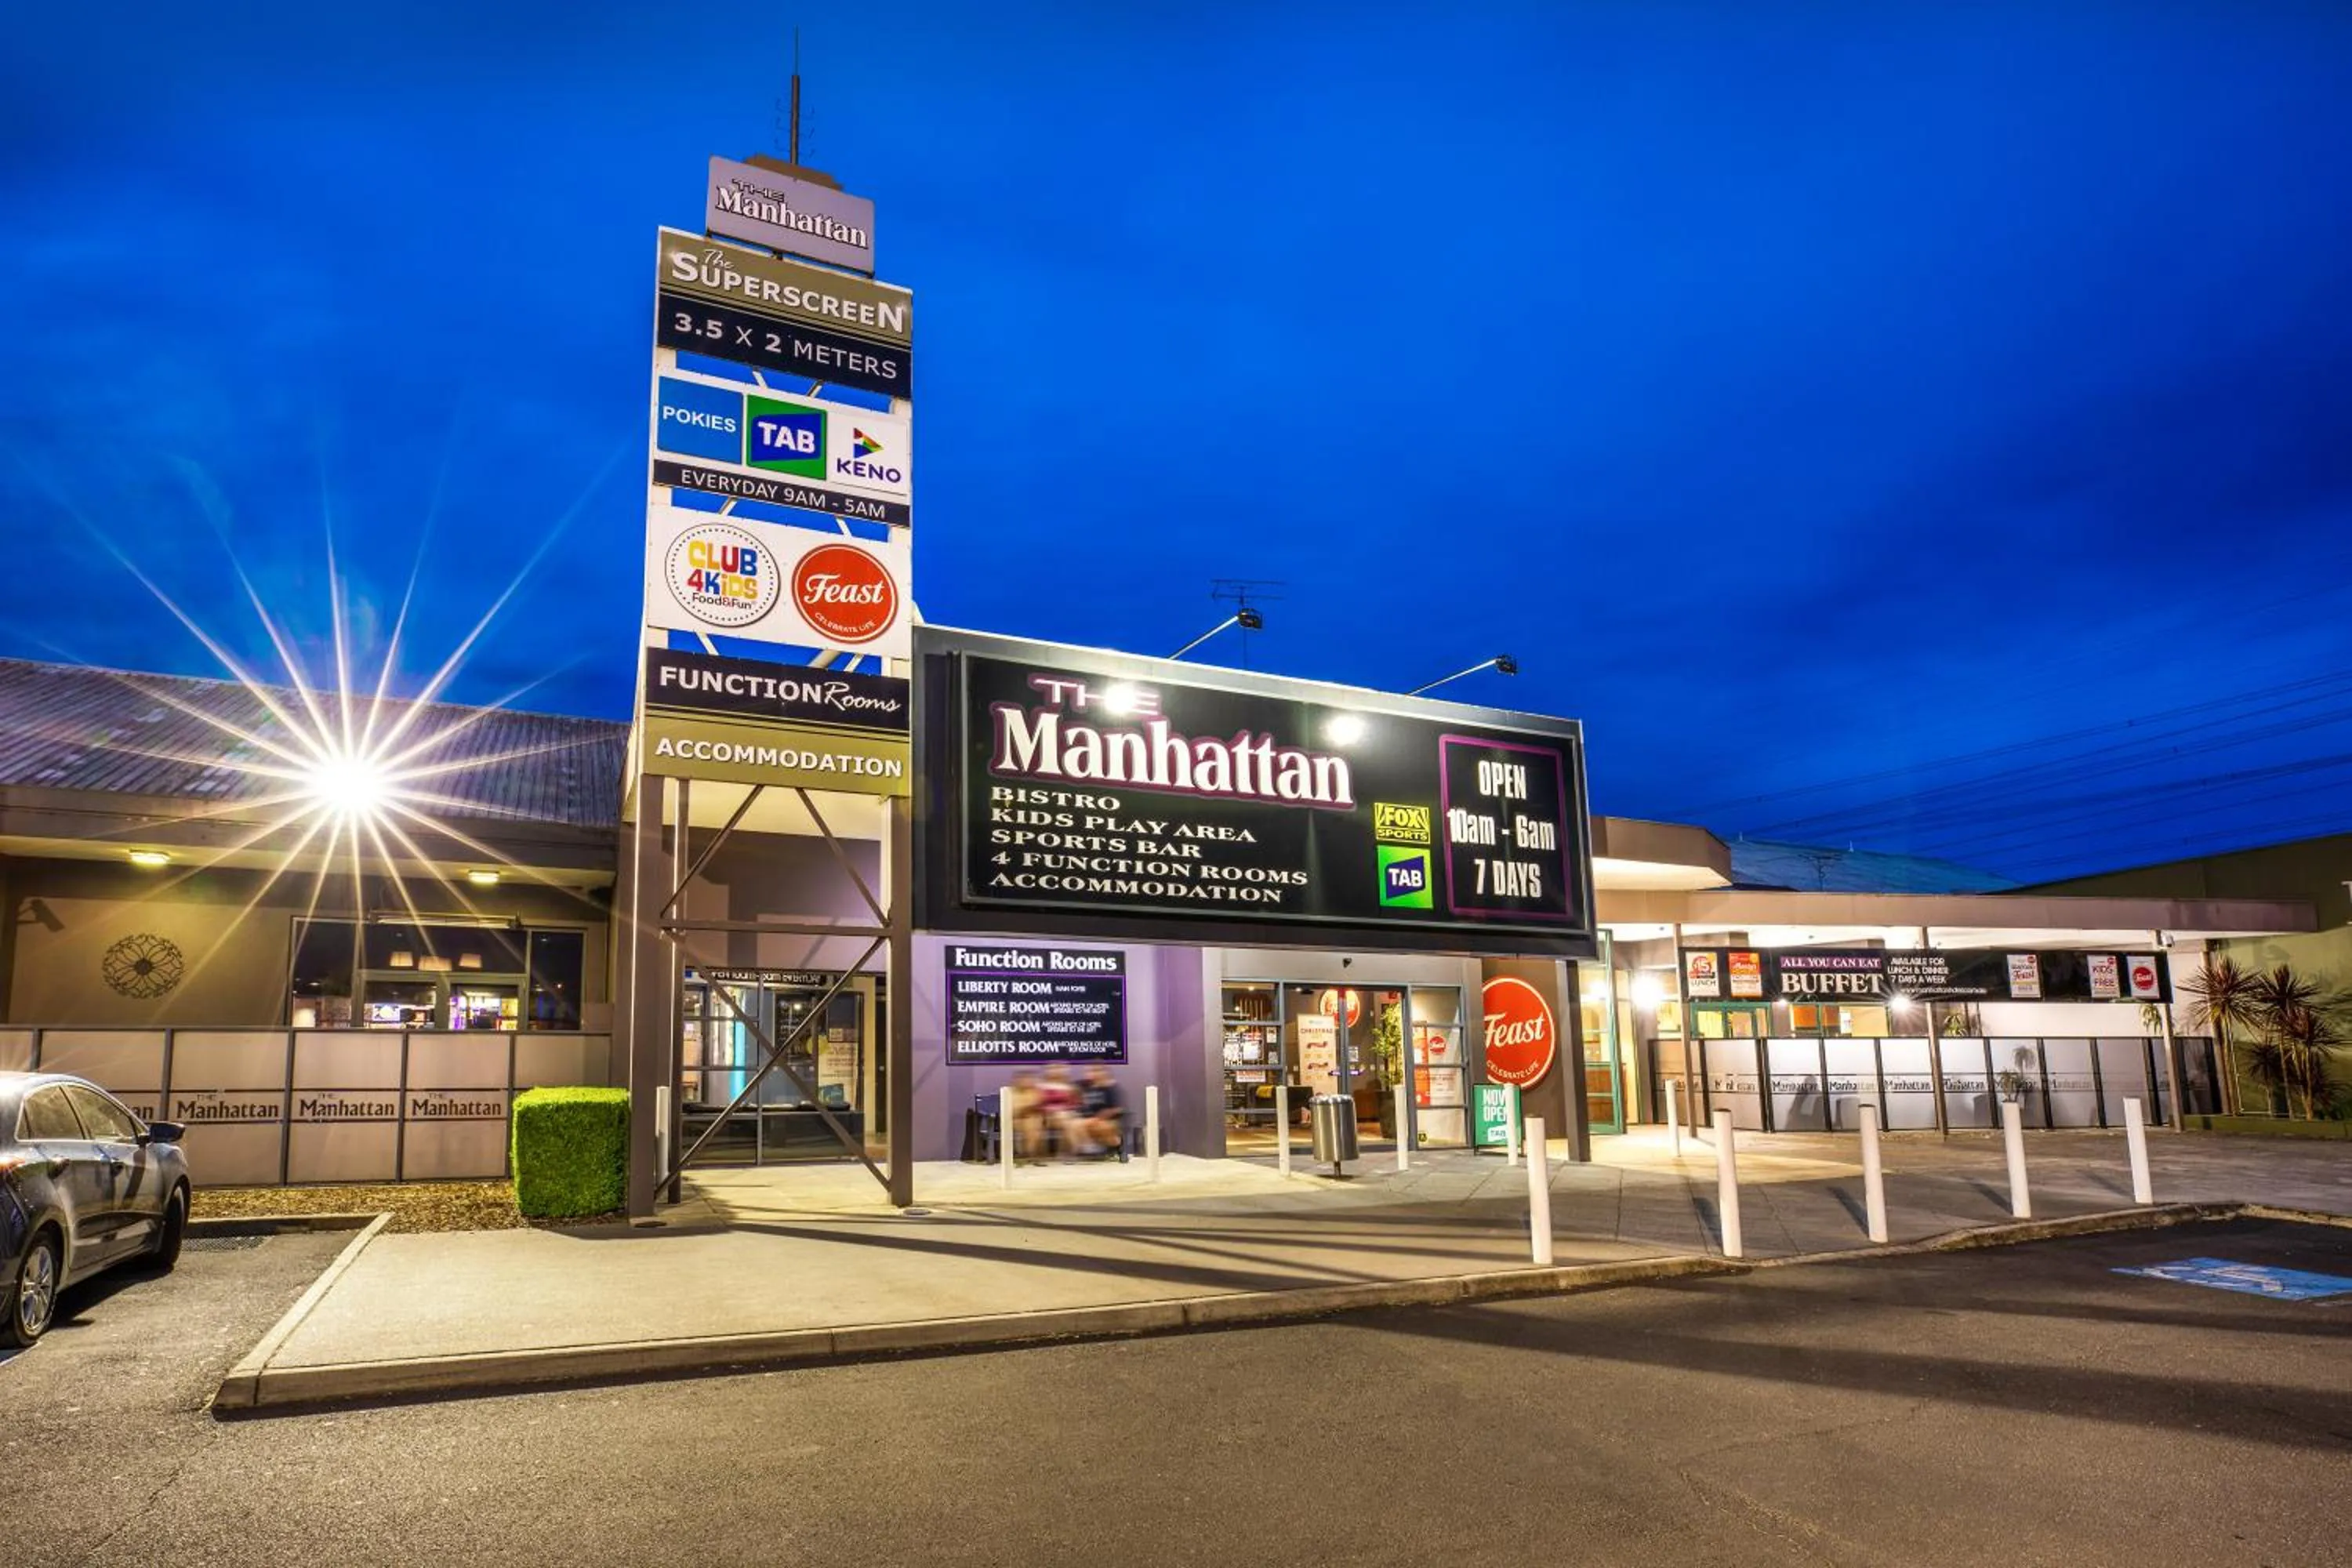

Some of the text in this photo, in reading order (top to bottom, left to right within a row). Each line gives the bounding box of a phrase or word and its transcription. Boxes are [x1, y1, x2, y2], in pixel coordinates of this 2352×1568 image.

[732, 179, 784, 201] THE
[715, 185, 869, 249] Manhattan
[704, 249, 734, 270] The
[672, 251, 904, 333] SUPERSCREEN
[675, 313, 722, 339] 3.5
[765, 333, 782, 354] 2
[794, 339, 897, 379] METERS
[662, 406, 736, 432] POKIES
[758, 421, 815, 453] TAB
[837, 458, 901, 483] KENO
[681, 470, 778, 499] EVERYDAY
[784, 489, 826, 509] 9AM
[844, 498, 885, 519] 5AM
[688, 541, 757, 575] CLUB
[804, 573, 884, 604] Feast
[659, 666, 900, 710] FUNCTION Rooms
[655, 739, 902, 777] ACCOMMODATION
[993, 707, 1355, 805] Manhattan
[1479, 760, 1526, 799] OPEN
[991, 786, 1120, 811] BISTRO
[991, 808, 1258, 842] KIDS PLAY AREA
[1385, 807, 1421, 828] FOX
[1447, 808, 1495, 845] 10am
[1516, 815, 1555, 850] 6am
[991, 829, 1203, 858] SPORTS BAR
[1377, 829, 1428, 840] SPORTS
[991, 851, 1308, 885] 4 FUNCTION ROOMS
[1388, 868, 1423, 887] TAB
[1475, 858, 1541, 898] 7 DAYS
[990, 872, 1283, 902] ACCOMMODATION
[955, 947, 1117, 970] Function Rooms
[1783, 957, 1880, 967] ALL YOU CAN EAT
[1929, 957, 1945, 966] FOR
[958, 981, 1008, 993] LIBERTY
[1011, 982, 1052, 994] ROOM
[1781, 973, 1883, 993] BUFFET
[1891, 975, 1896, 983] 7
[957, 1000, 1051, 1013] EMPIRE ROOM
[957, 1021, 996, 1033] SOHO
[1000, 1021, 1040, 1033] ROOM
[1484, 1011, 1544, 1050] Feast
[957, 1041, 1015, 1053] ELLIOTTS
[1019, 1041, 1059, 1053] ROOM
[176, 1101, 279, 1119] Manhattan
[299, 1098, 395, 1116] Manhattan
[412, 1098, 501, 1116] Manhattan
